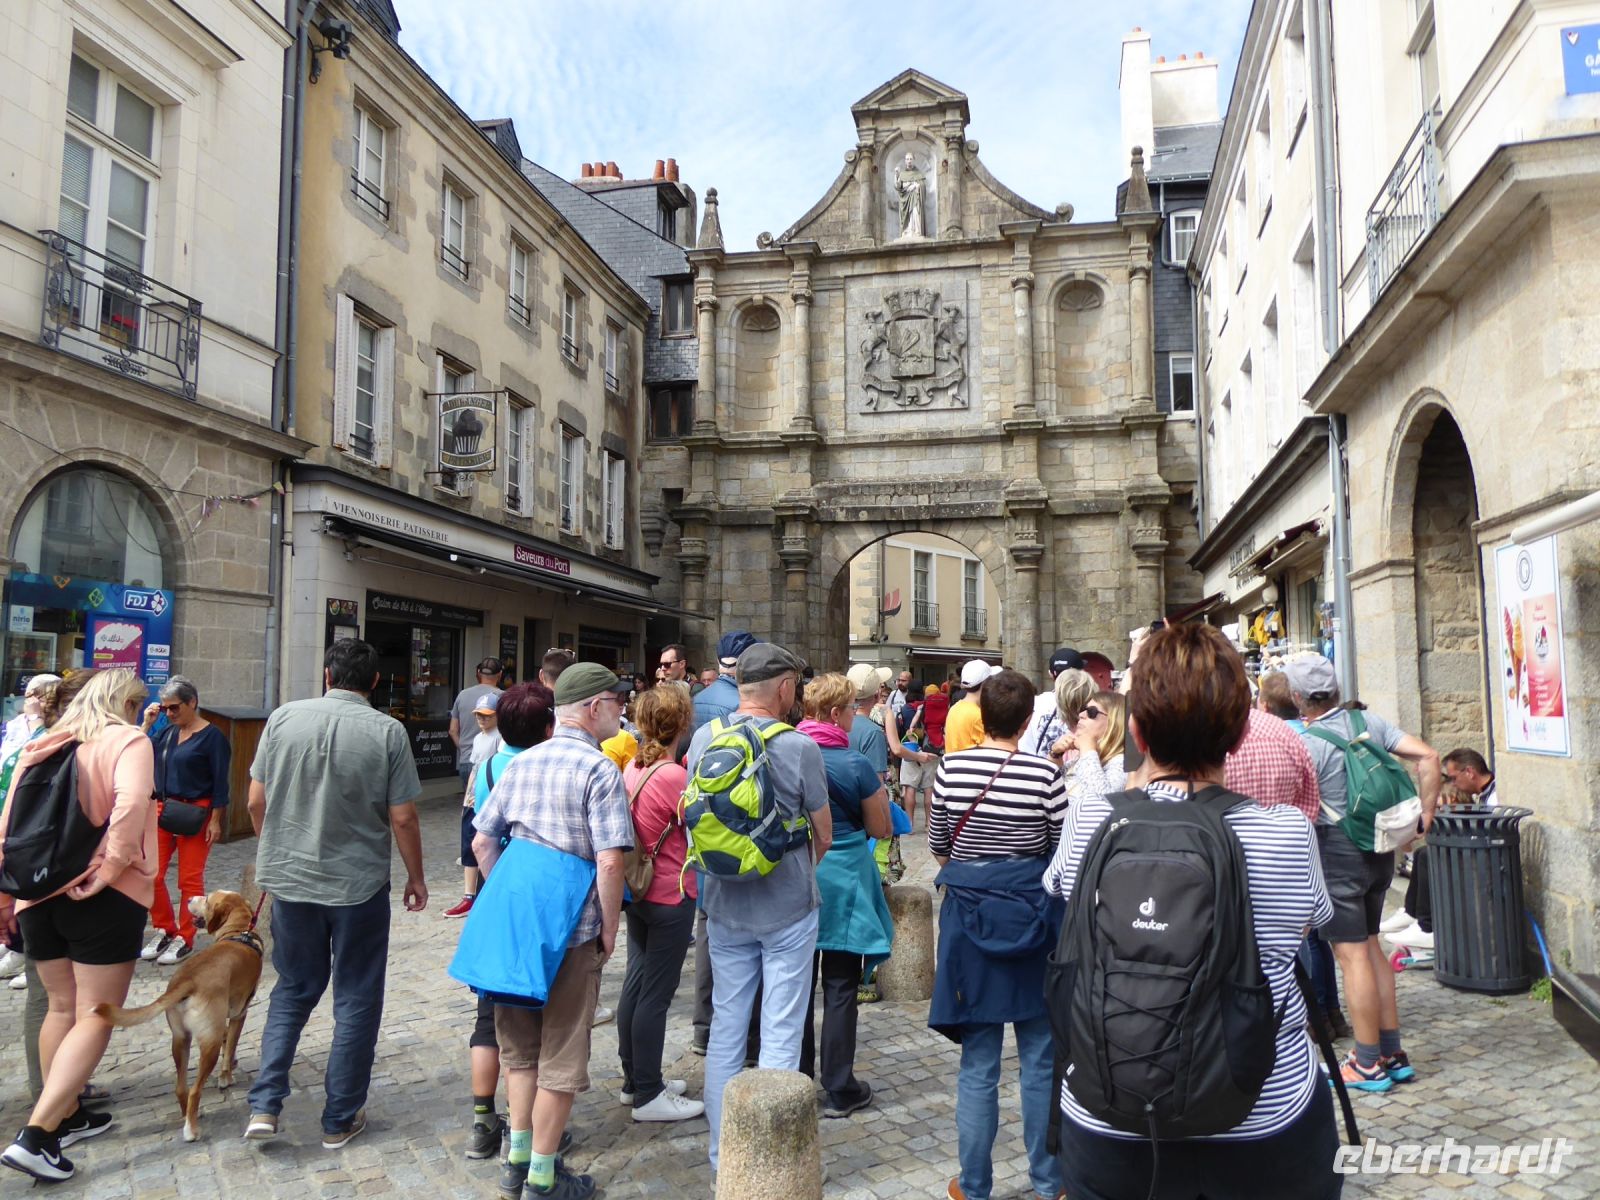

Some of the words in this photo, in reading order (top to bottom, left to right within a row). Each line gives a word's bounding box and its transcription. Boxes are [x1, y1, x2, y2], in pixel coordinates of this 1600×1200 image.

[333, 501, 401, 529] VIENNOISERIE
[403, 522, 449, 543] PATISSERIE
[516, 545, 545, 566] Saveurs
[545, 559, 555, 568] du
[554, 557, 569, 573] Port
[126, 594, 148, 608] FDJ
[1131, 918, 1168, 931] deuter
